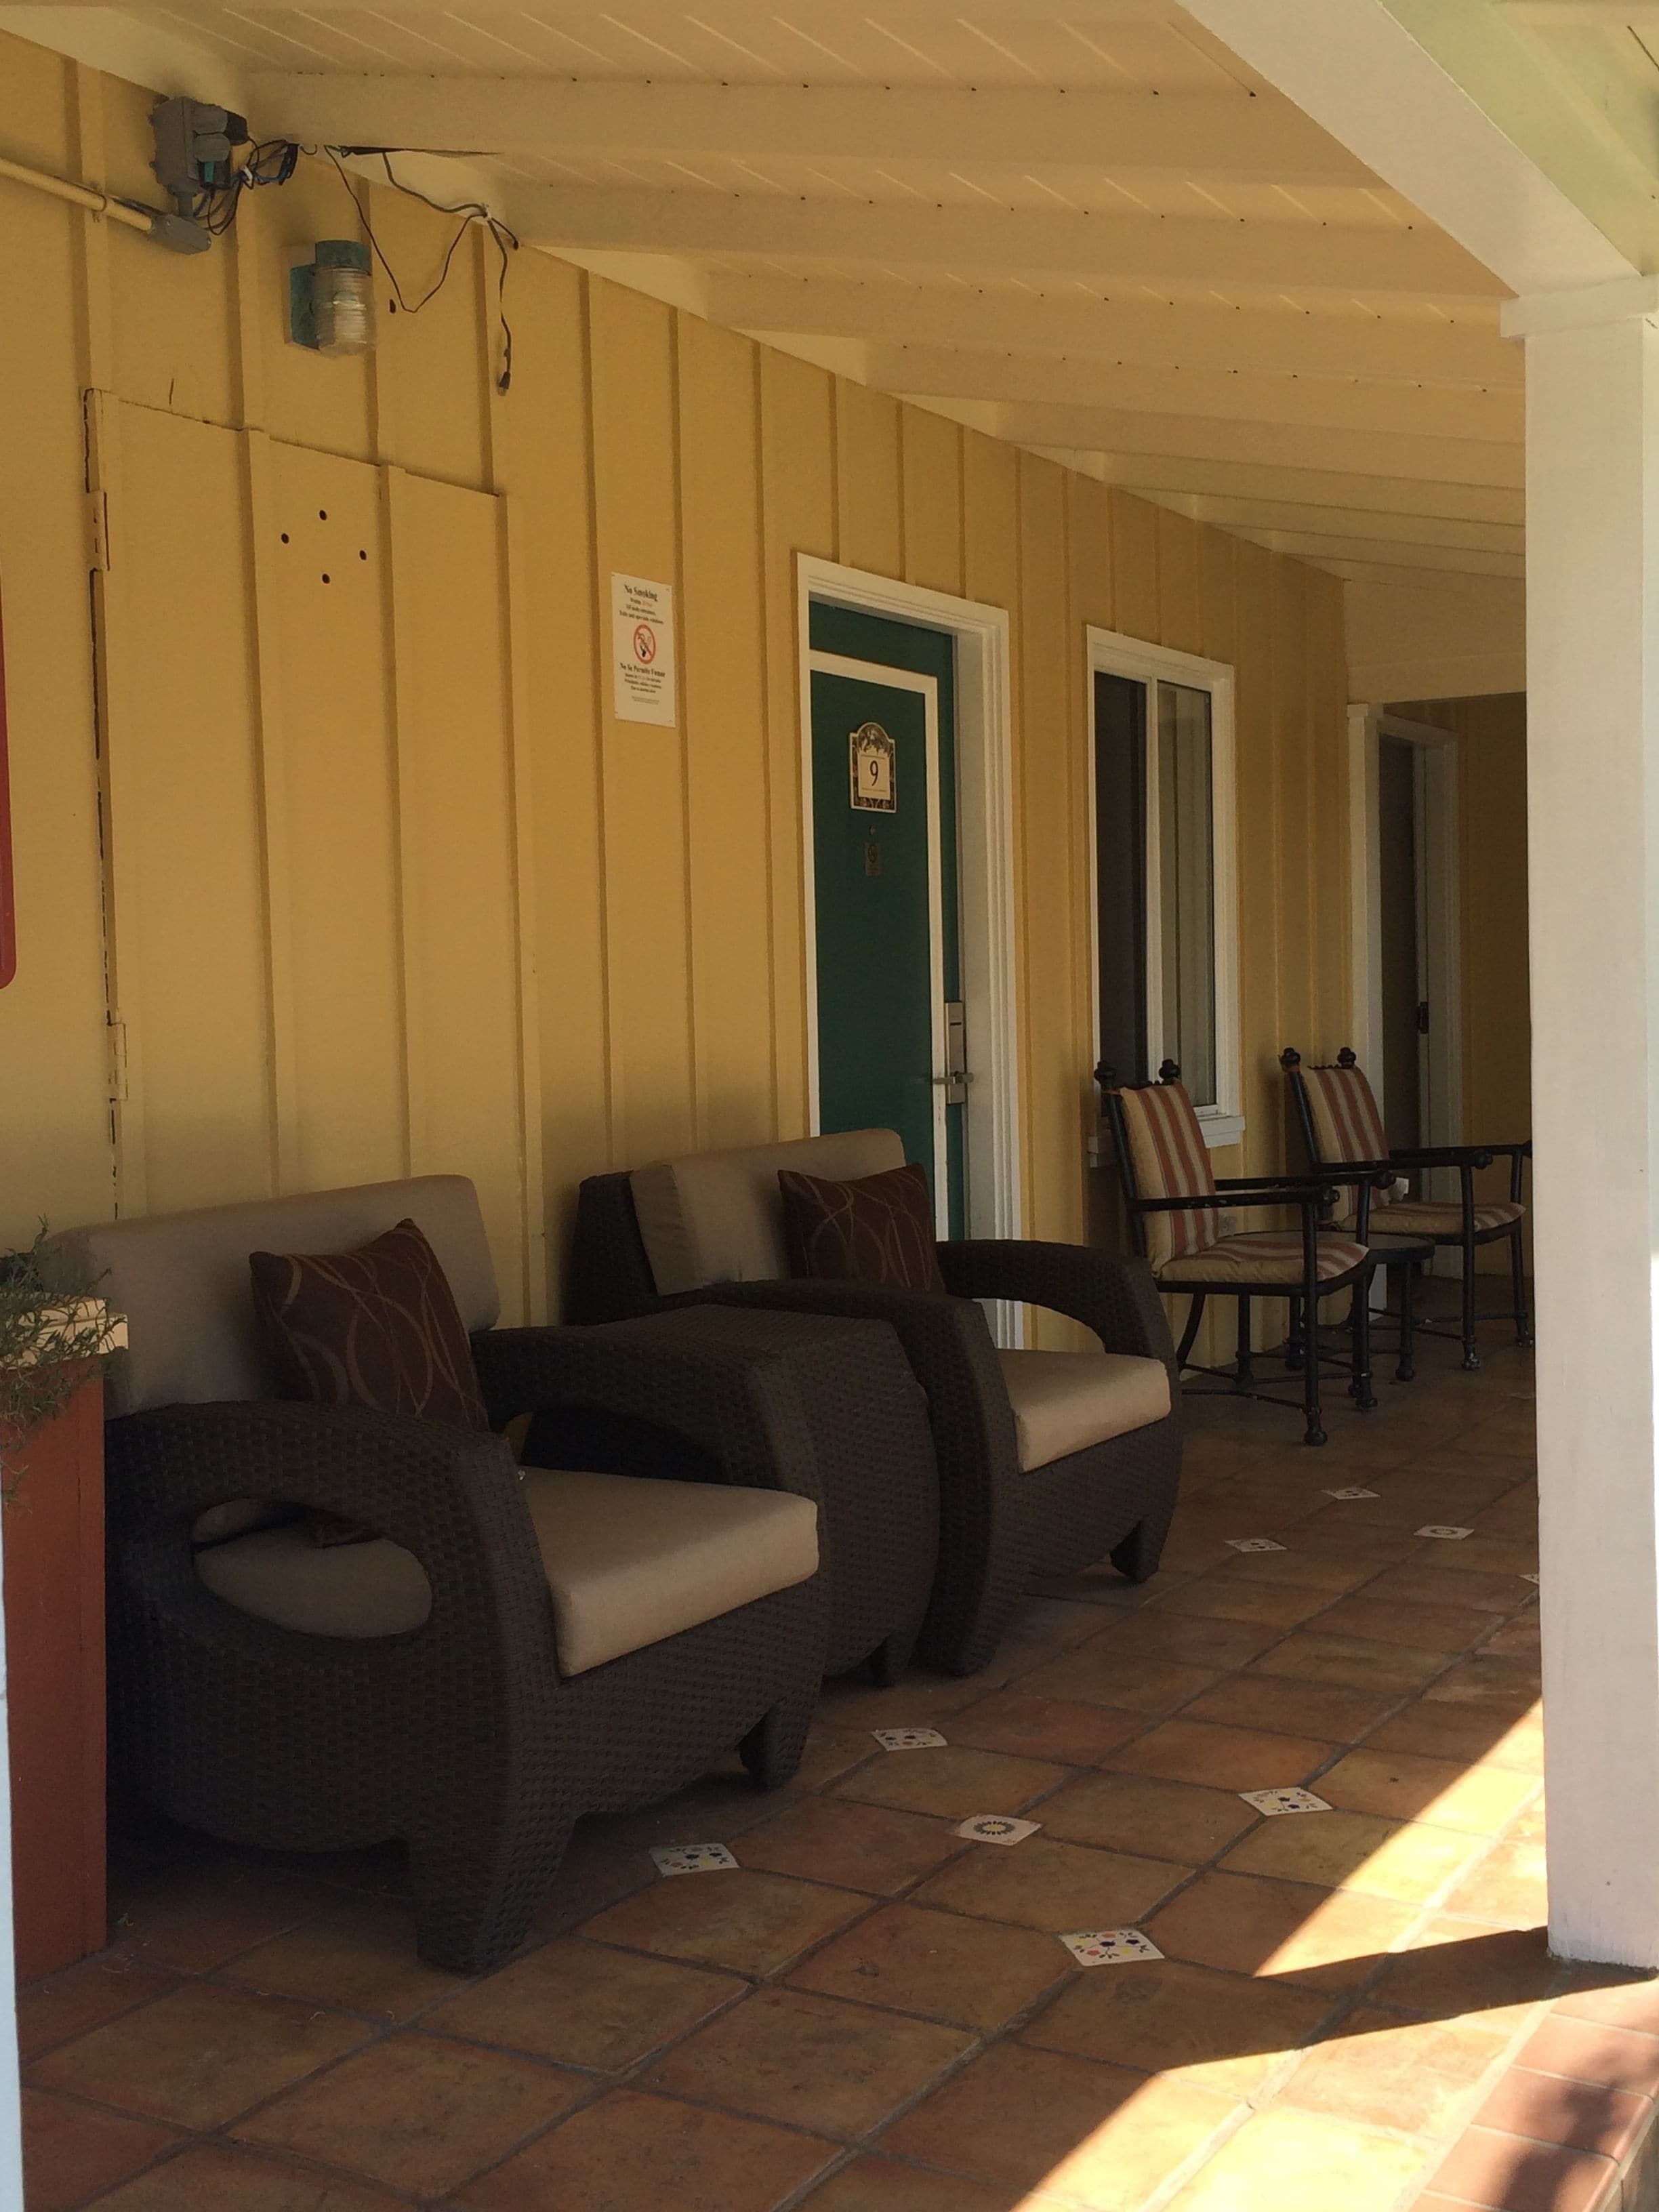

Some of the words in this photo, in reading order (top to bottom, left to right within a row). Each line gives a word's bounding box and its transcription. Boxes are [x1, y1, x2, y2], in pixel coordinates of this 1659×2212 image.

[624, 584, 632, 594] No
[634, 586, 658, 602] Smoking
[870, 760, 878, 786] 9
